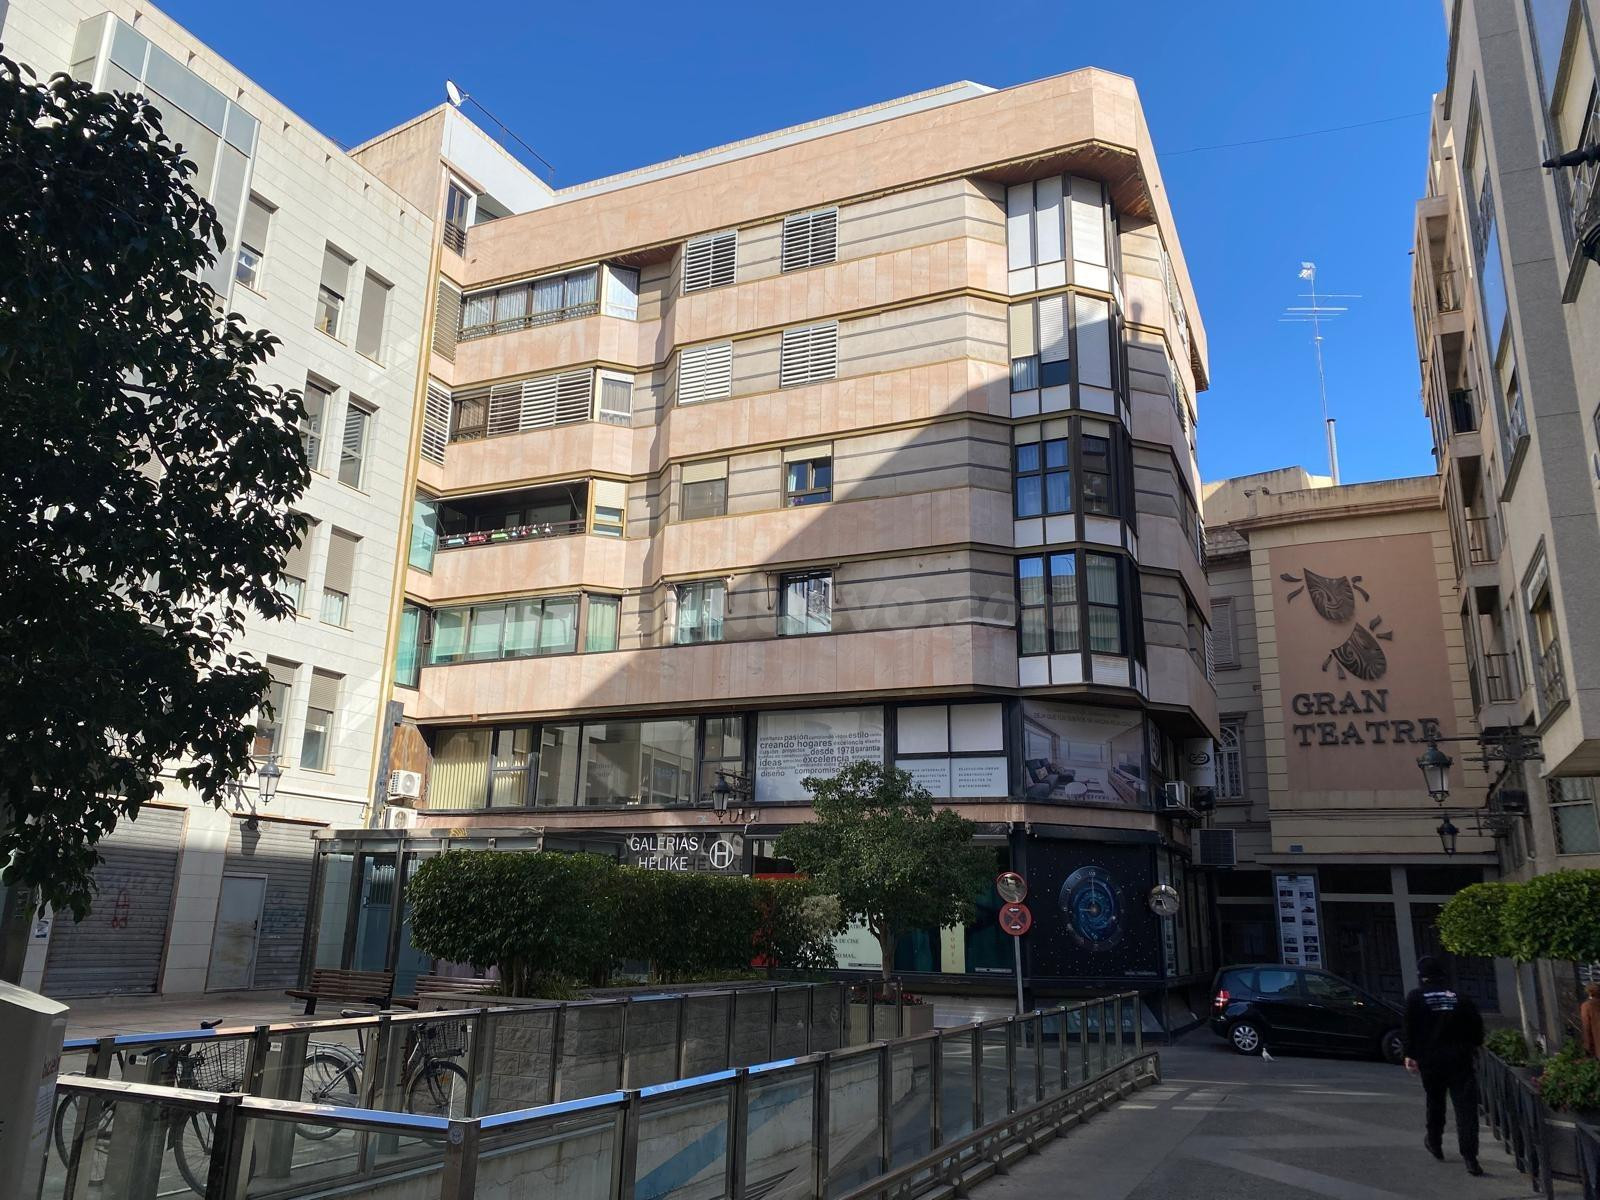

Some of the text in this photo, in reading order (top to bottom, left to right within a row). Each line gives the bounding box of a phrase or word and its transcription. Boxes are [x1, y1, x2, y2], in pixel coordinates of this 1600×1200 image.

[1292, 688, 1389, 715] GRAN
[1293, 717, 1442, 746] TEATRE
[760, 740, 794, 749] creando
[797, 739, 832, 749] hogares
[810, 747, 834, 755] desde
[837, 746, 854, 754] 1978
[759, 758, 782, 766] ideas
[802, 755, 849, 763] excelencia
[794, 767, 841, 775] compromiso
[630, 836, 699, 851] GALERIAS
